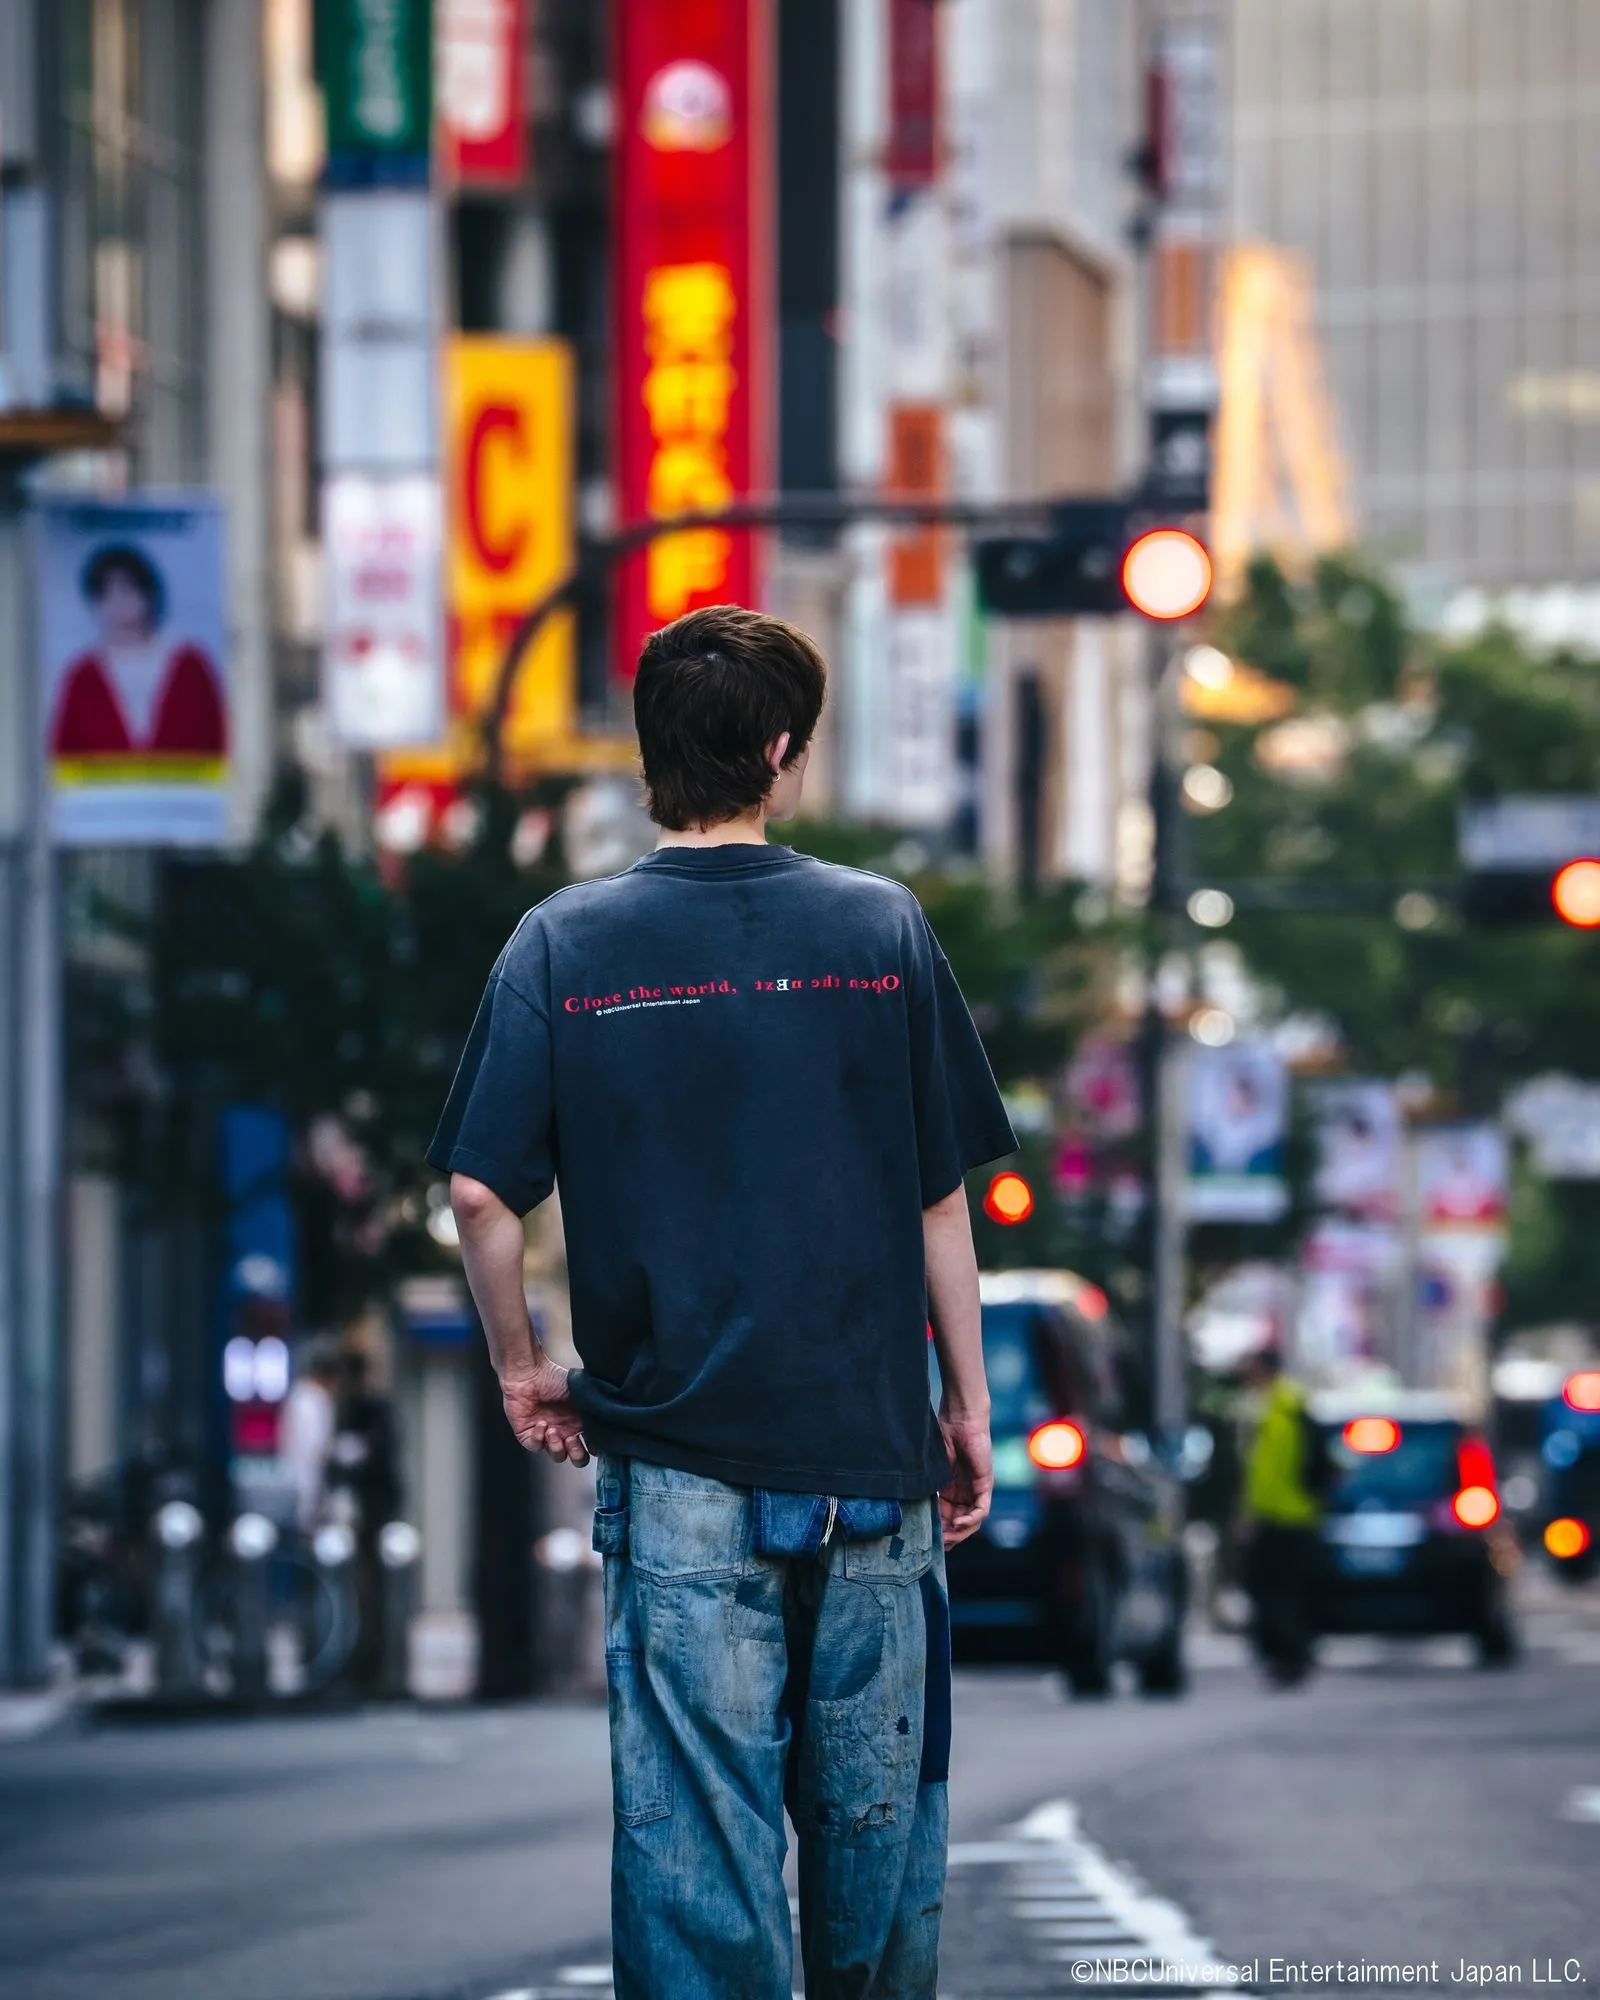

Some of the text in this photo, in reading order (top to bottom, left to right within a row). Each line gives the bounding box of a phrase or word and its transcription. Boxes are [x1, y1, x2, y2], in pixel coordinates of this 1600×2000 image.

[564, 980, 737, 1013] Close the world,
[603, 1002, 641, 1015] NBCUniversal
[642, 999, 680, 1008] Entertainment
